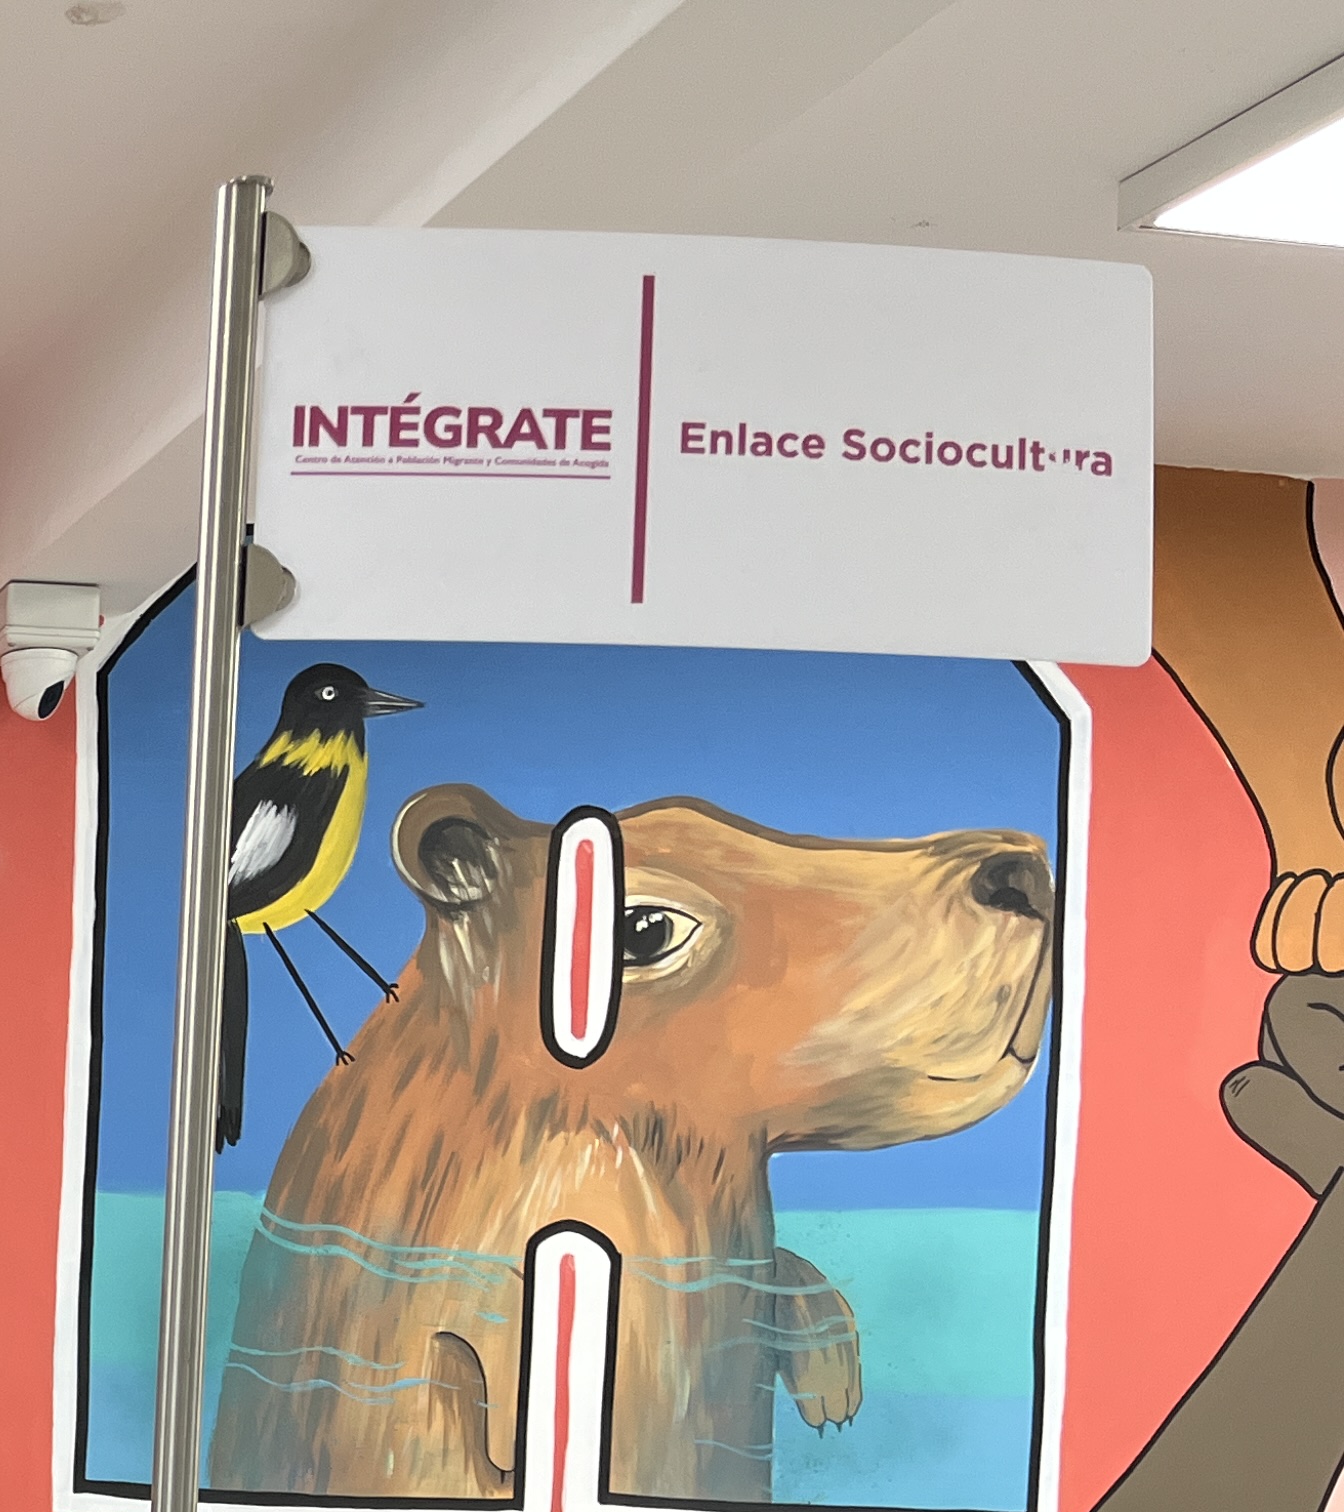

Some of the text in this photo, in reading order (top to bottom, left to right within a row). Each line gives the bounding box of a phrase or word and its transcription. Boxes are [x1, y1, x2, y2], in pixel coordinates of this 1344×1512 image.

[292, 392, 613, 451] INTÉGRATE
[680, 421, 826, 459] Enlace
[295, 455, 327, 464] Centro
[331, 455, 341, 464] de
